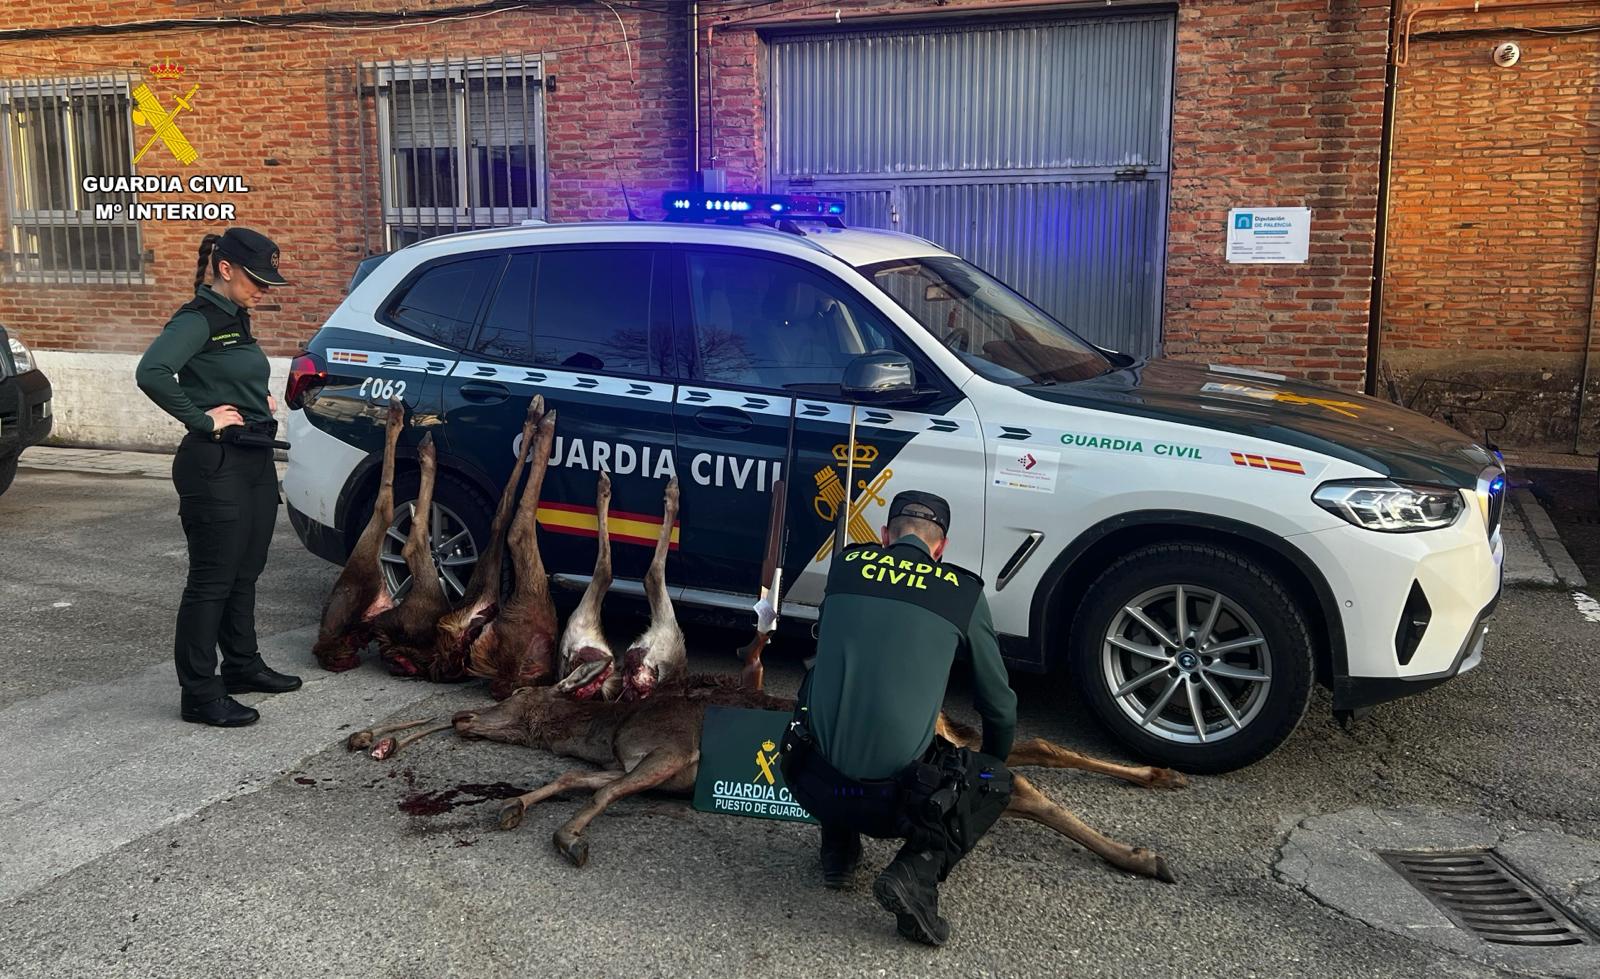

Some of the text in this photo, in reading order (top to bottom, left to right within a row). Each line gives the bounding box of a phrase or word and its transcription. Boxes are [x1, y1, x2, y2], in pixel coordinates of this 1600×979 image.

[371, 378, 407, 400] 062
[1060, 434, 1202, 459] GUARDIA CIVIL
[845, 551, 959, 586] GUARDIA
[861, 564, 927, 589] CIVIL
[713, 780, 775, 800] GUARDIA
[715, 799, 753, 812] PUESTO
[754, 803, 767, 813] DE
